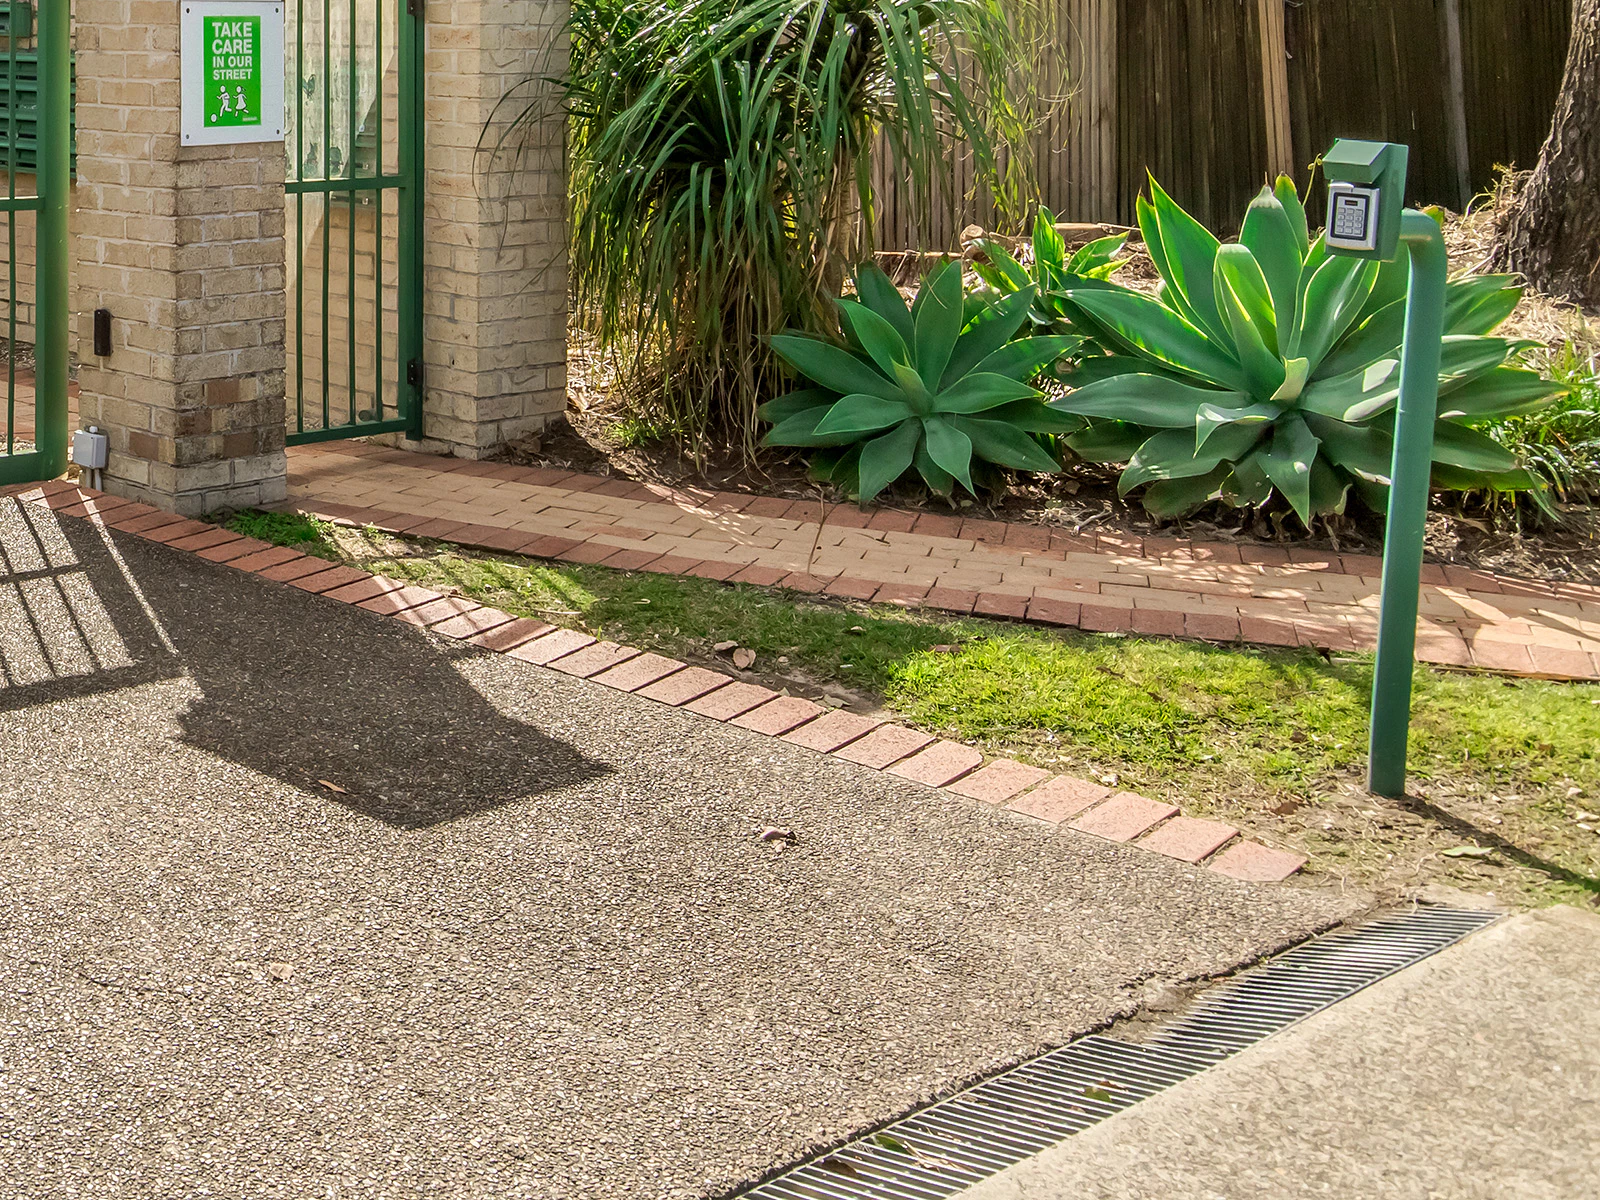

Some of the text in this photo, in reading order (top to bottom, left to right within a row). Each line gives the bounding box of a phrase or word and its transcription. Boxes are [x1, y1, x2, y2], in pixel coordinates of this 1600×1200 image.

[212, 22, 252, 38] TAKE
[212, 38, 252, 54] CARE
[212, 55, 252, 68] IN OUR
[213, 68, 252, 80] STREET
